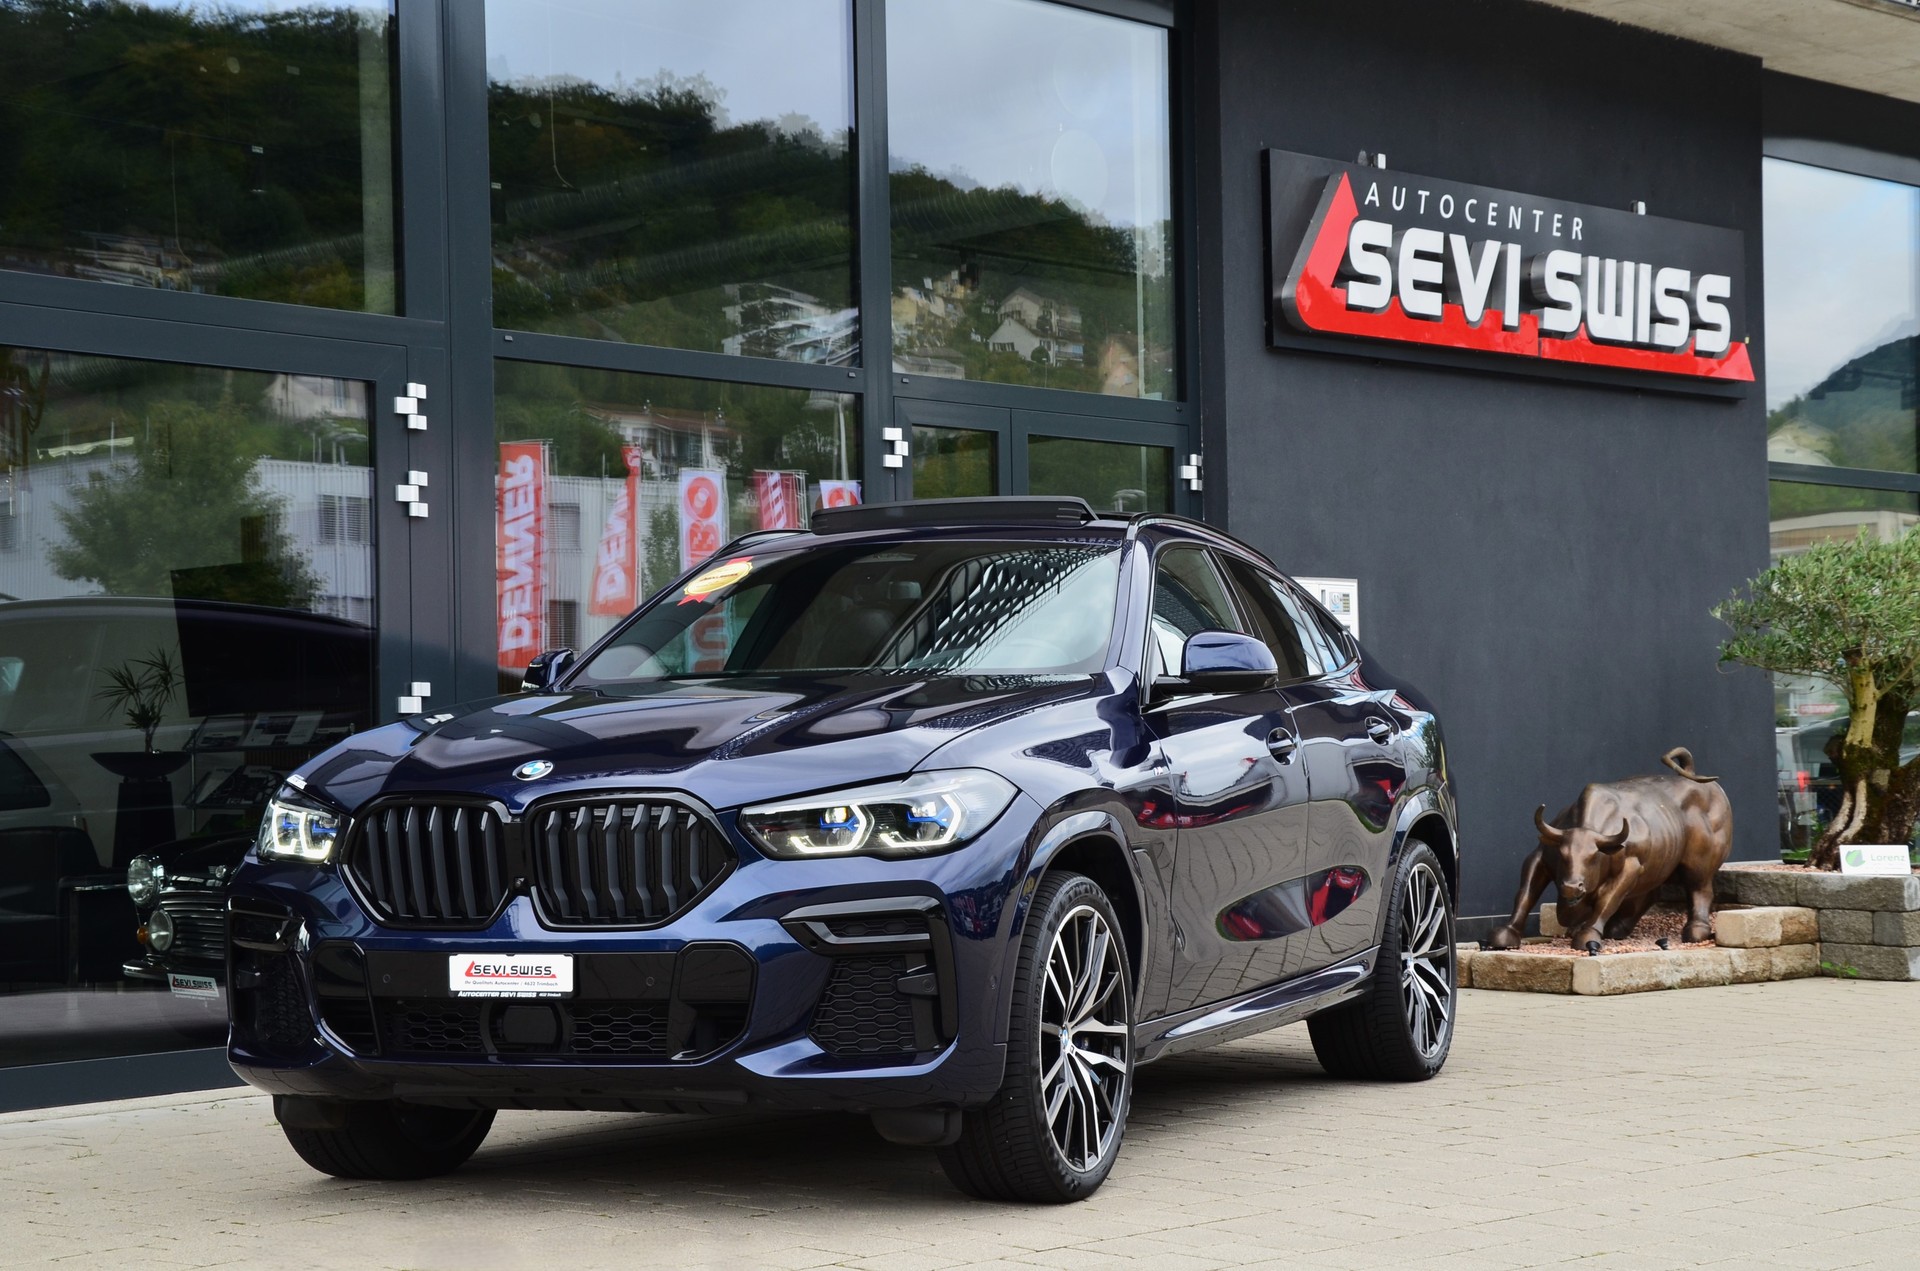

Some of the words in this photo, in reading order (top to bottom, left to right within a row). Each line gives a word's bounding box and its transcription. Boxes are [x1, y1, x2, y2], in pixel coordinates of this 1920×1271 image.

[1364, 182, 1584, 240] AUTOCENTER
[1346, 219, 1521, 328] SEVI
[1543, 249, 1731, 353] SWISS
[1871, 854, 1905, 862] Lorenz
[473, 964, 506, 975] SEVI
[510, 965, 552, 976] SWISS
